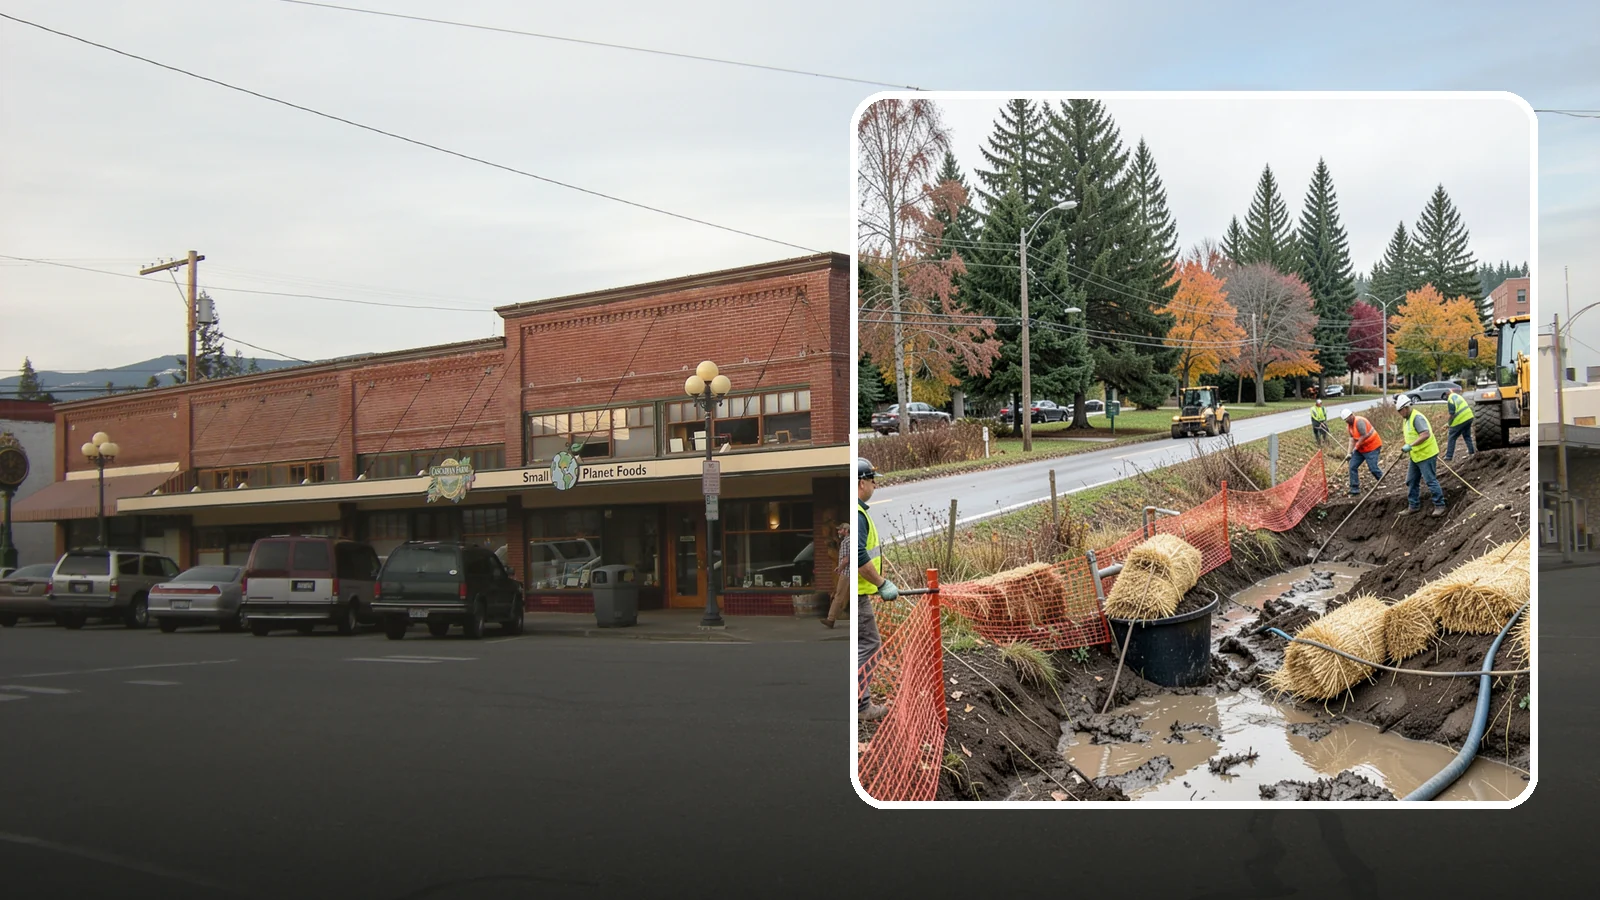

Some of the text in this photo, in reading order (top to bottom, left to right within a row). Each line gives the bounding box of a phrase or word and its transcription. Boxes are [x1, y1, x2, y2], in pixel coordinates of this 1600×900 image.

[523, 464, 647, 483] Small Planet Foods
